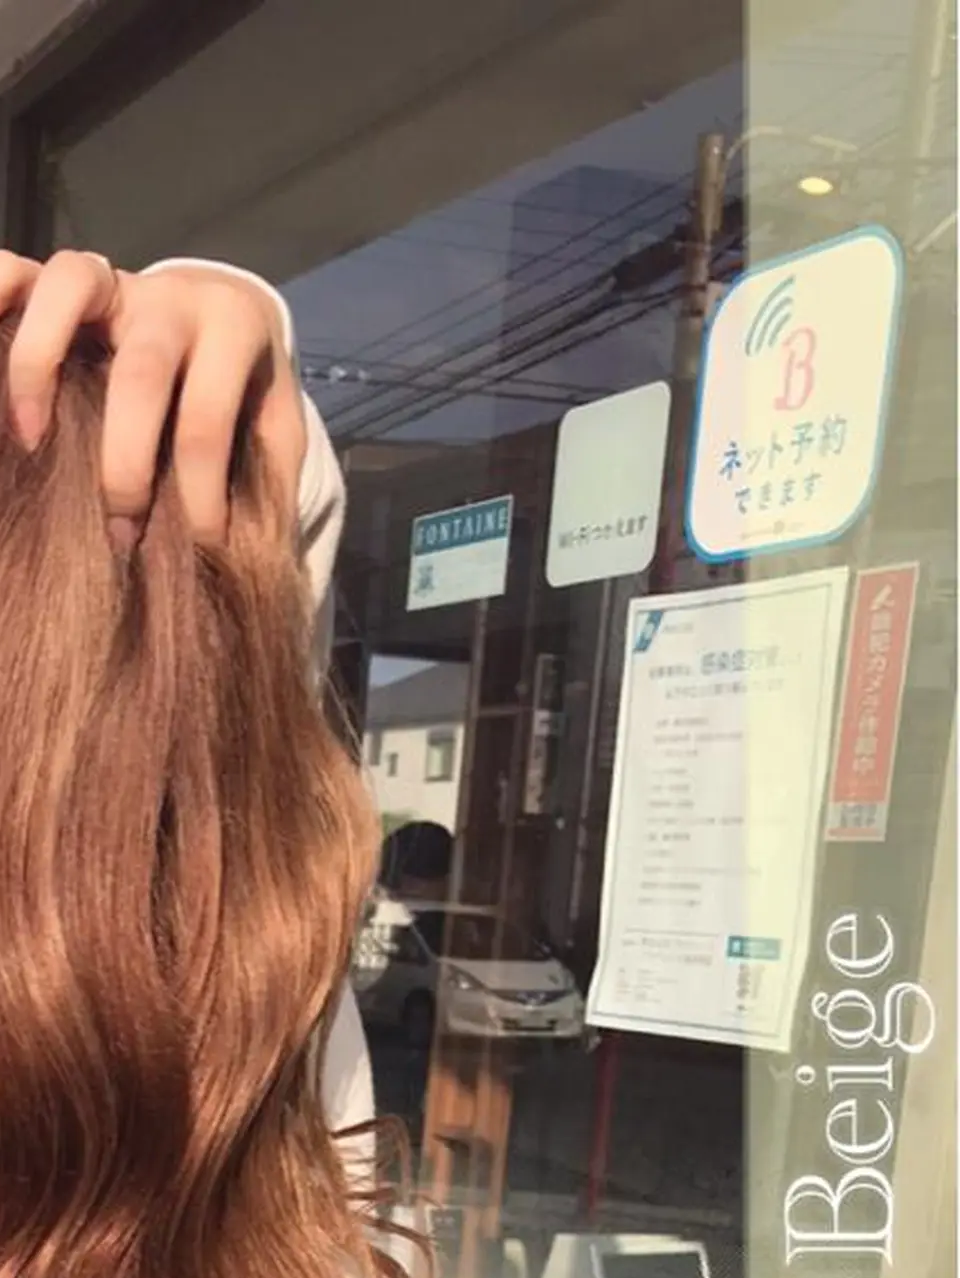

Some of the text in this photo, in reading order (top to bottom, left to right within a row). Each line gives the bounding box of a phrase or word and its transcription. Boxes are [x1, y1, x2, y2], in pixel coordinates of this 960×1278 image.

[718, 415, 849, 482] ネット予約
[734, 471, 823, 514] できます
[414, 506, 508, 548] FONTAINE
